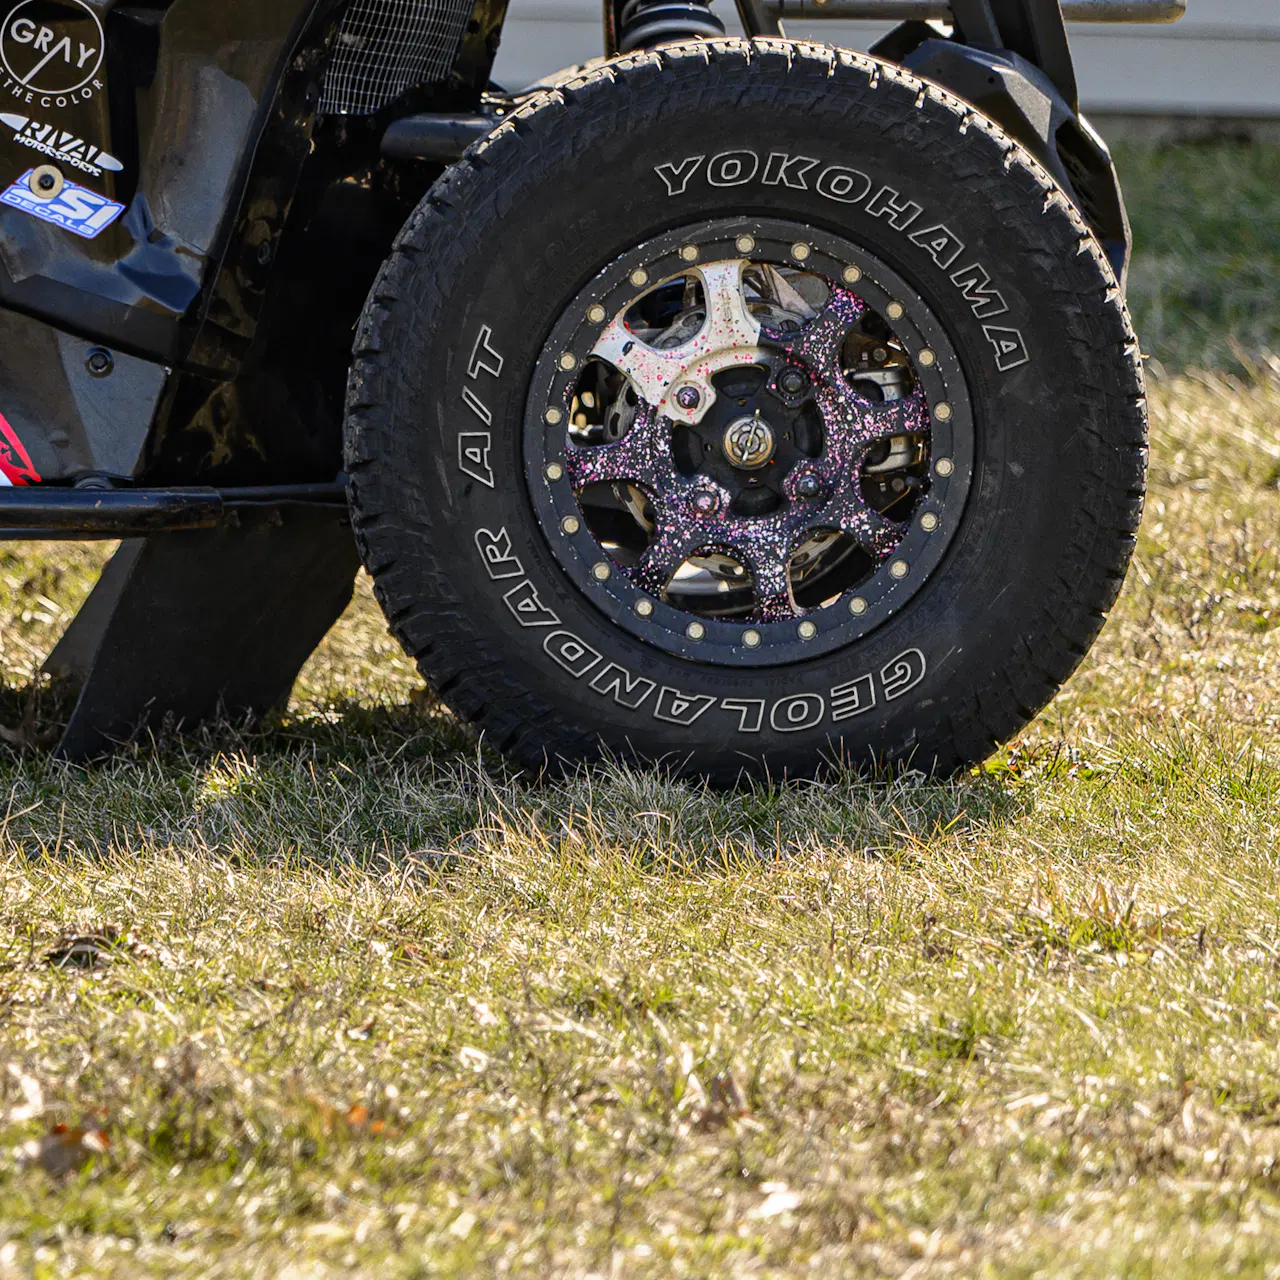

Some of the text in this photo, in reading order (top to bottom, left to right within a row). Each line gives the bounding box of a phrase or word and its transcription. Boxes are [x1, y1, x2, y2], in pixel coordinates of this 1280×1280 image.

[11, 18, 96, 85] GRAY
[3, 78, 34, 104] THE
[40, 79, 104, 108] COLOR
[13, 132, 102, 177] MOTORSPORTS
[2, 193, 96, 236] DECALS
[653, 149, 1033, 373] YOKOHAMA
[456, 324, 506, 489] A/T
[474, 526, 927, 734] GEOLANDAR
